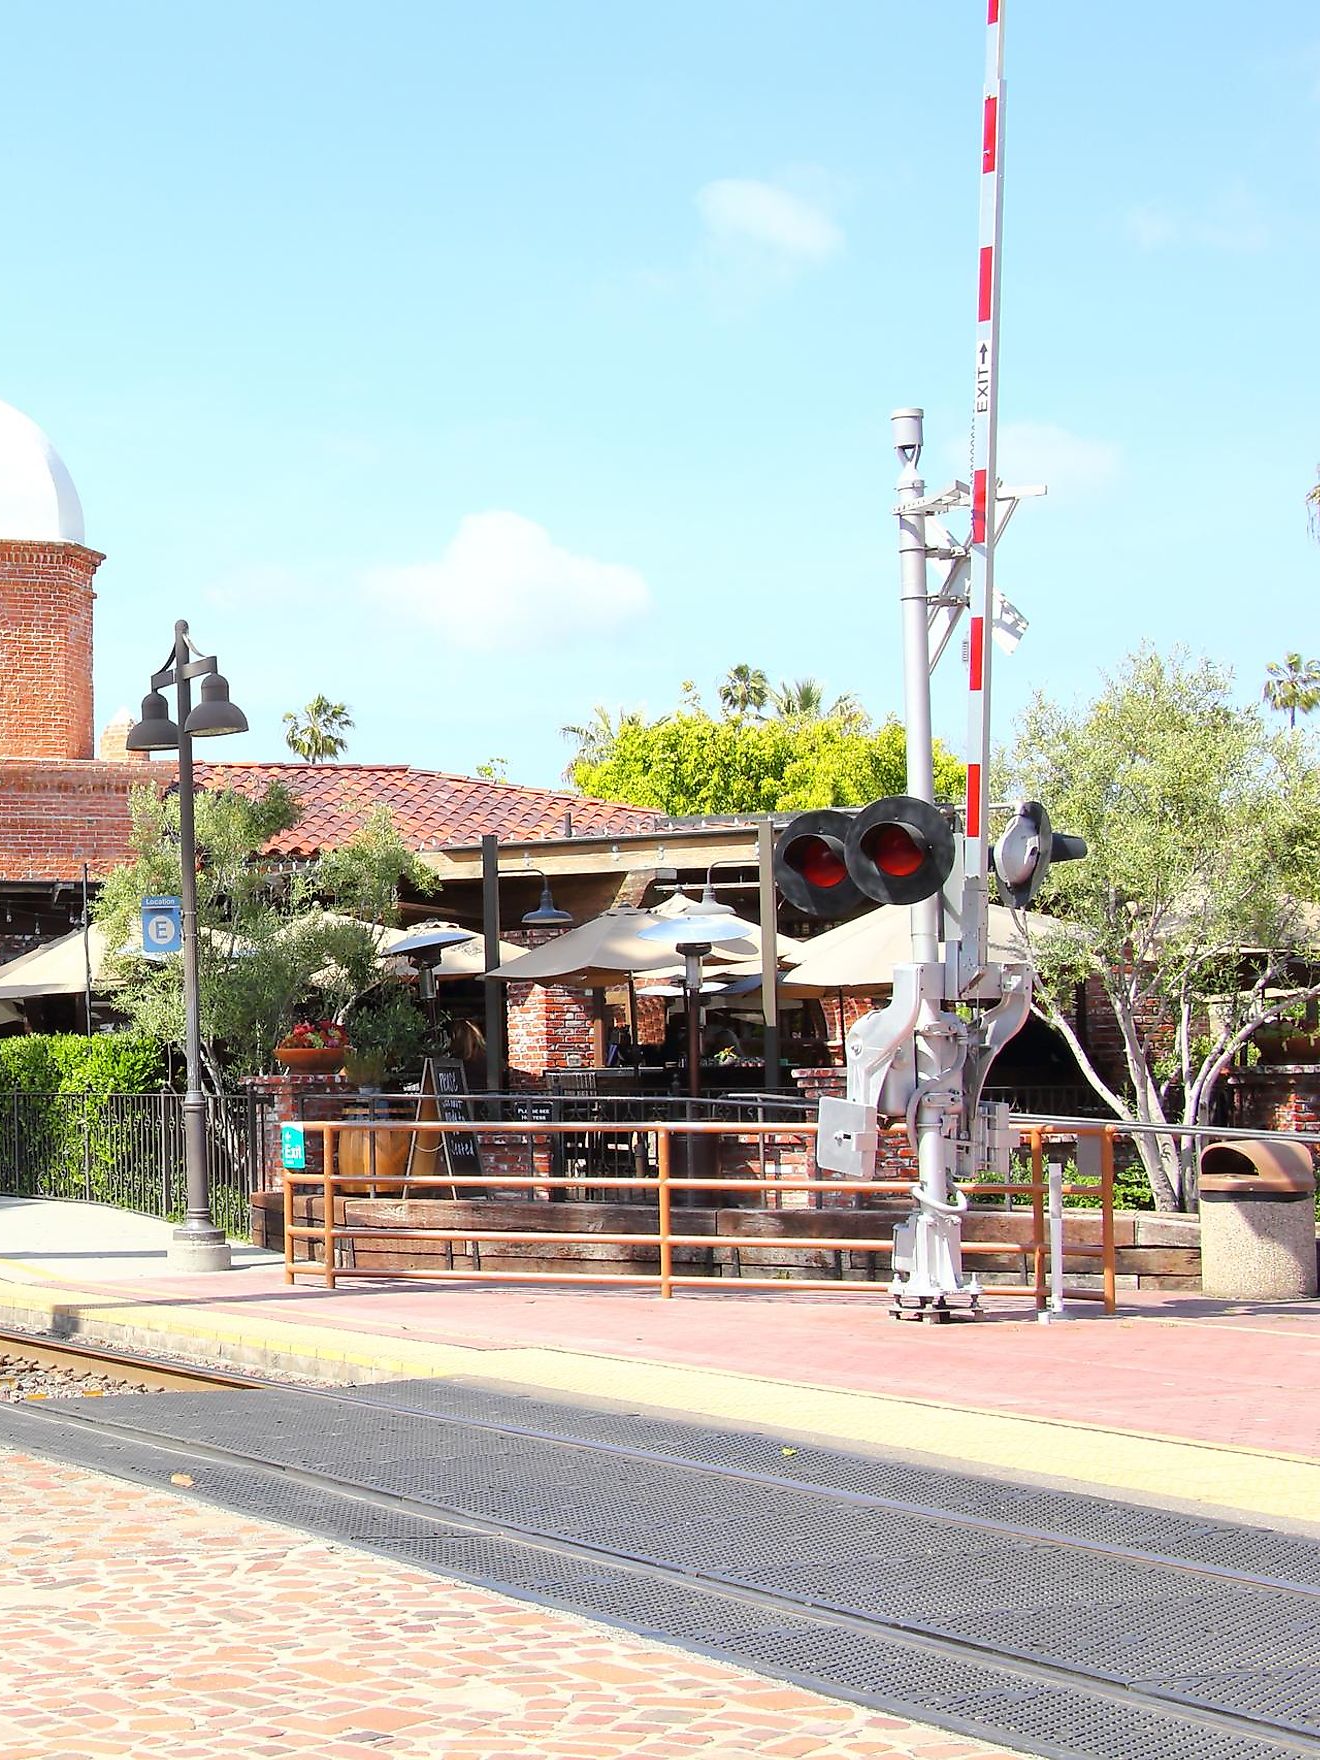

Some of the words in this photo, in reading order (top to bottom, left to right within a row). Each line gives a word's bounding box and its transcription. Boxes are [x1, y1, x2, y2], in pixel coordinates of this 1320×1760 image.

[977, 366, 989, 413] EXIT
[155, 920, 168, 939] E
[284, 1143, 302, 1159] Exit
